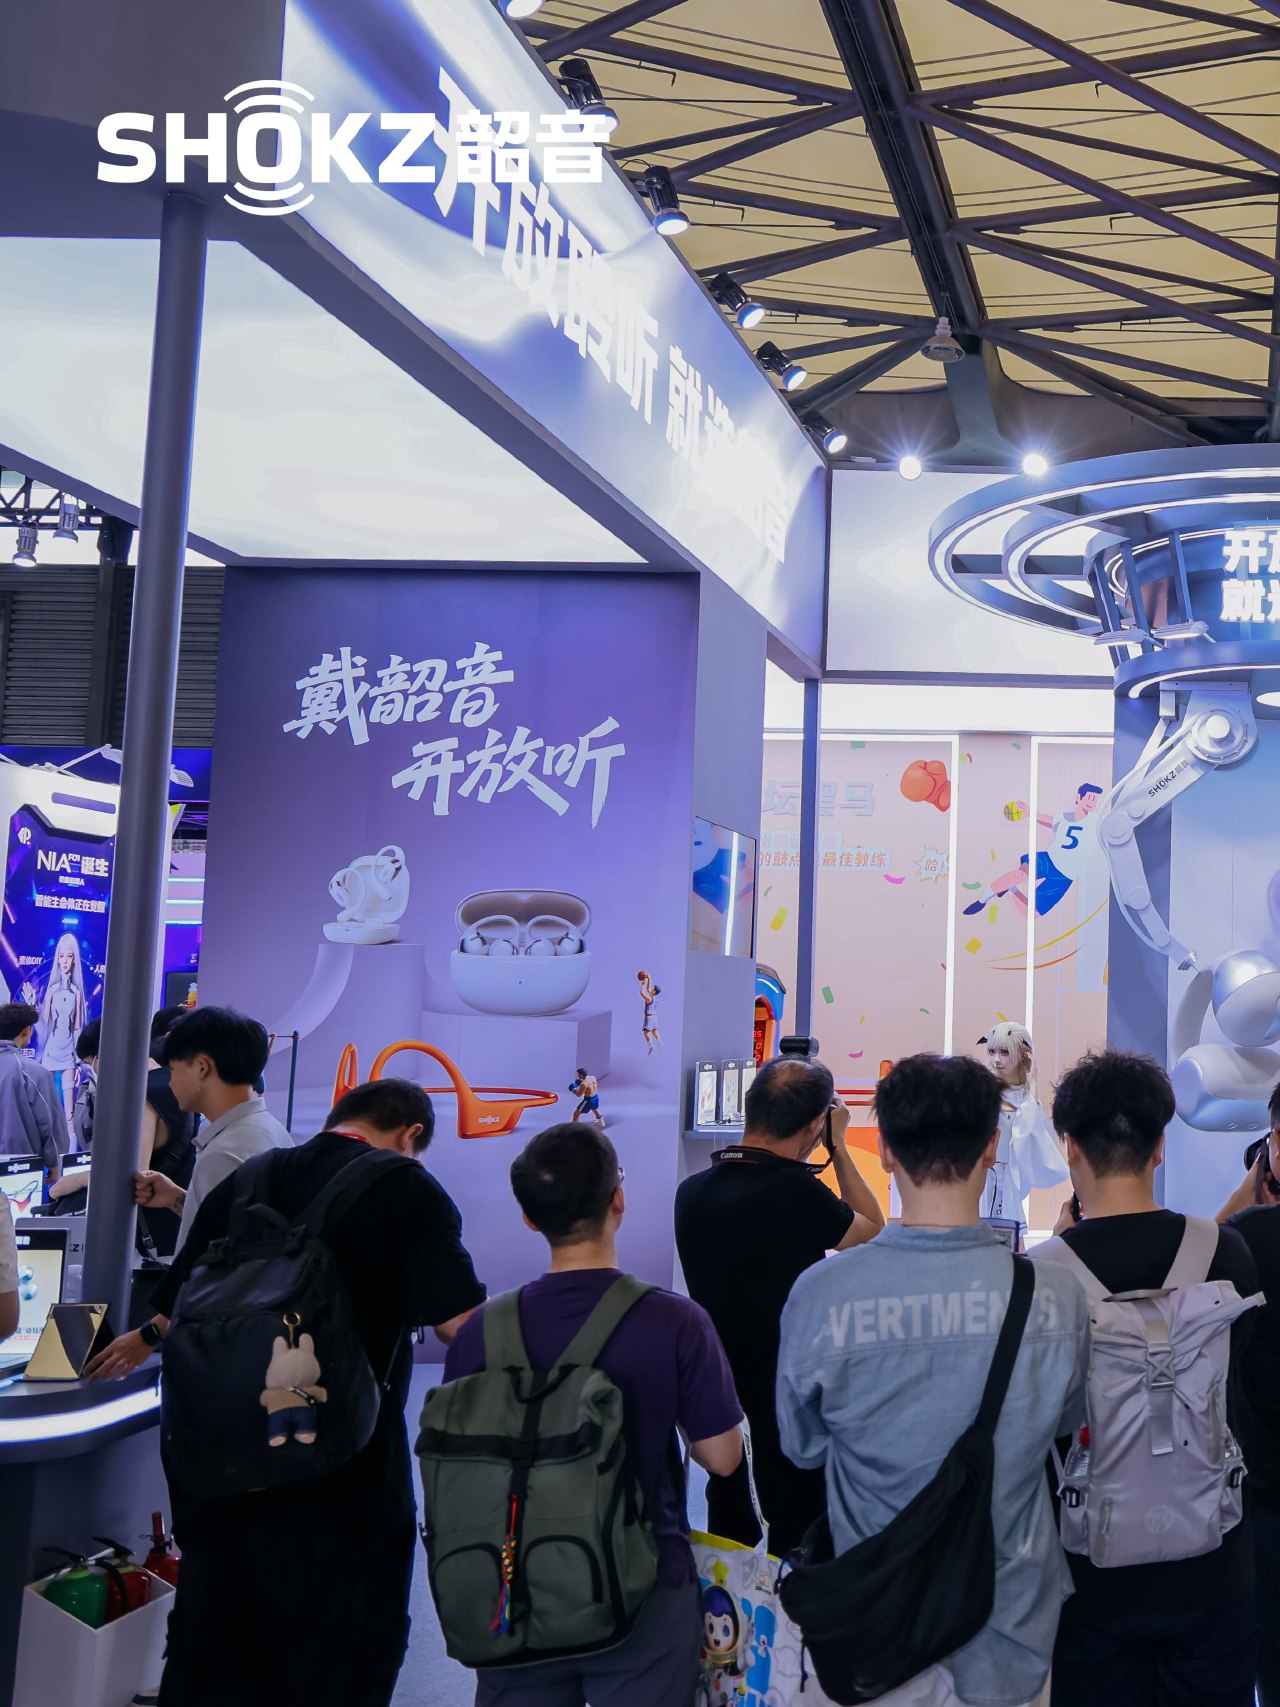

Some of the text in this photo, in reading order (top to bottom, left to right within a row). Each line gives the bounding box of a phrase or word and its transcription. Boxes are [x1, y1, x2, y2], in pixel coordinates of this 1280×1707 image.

[282, 641, 515, 746] 戴韶音
[391, 716, 626, 829] 开放听
[1148, 770, 1177, 798] SHOKZ
[1061, 825, 1083, 850] 5
[37, 849, 72, 874] NIA
[81, 856, 110, 878] 诞生
[759, 850, 888, 869] 的鼓点最佳教练
[720, 1151, 743, 1160] Canon
[828, 1280, 1058, 1349] VERTMÉNS
